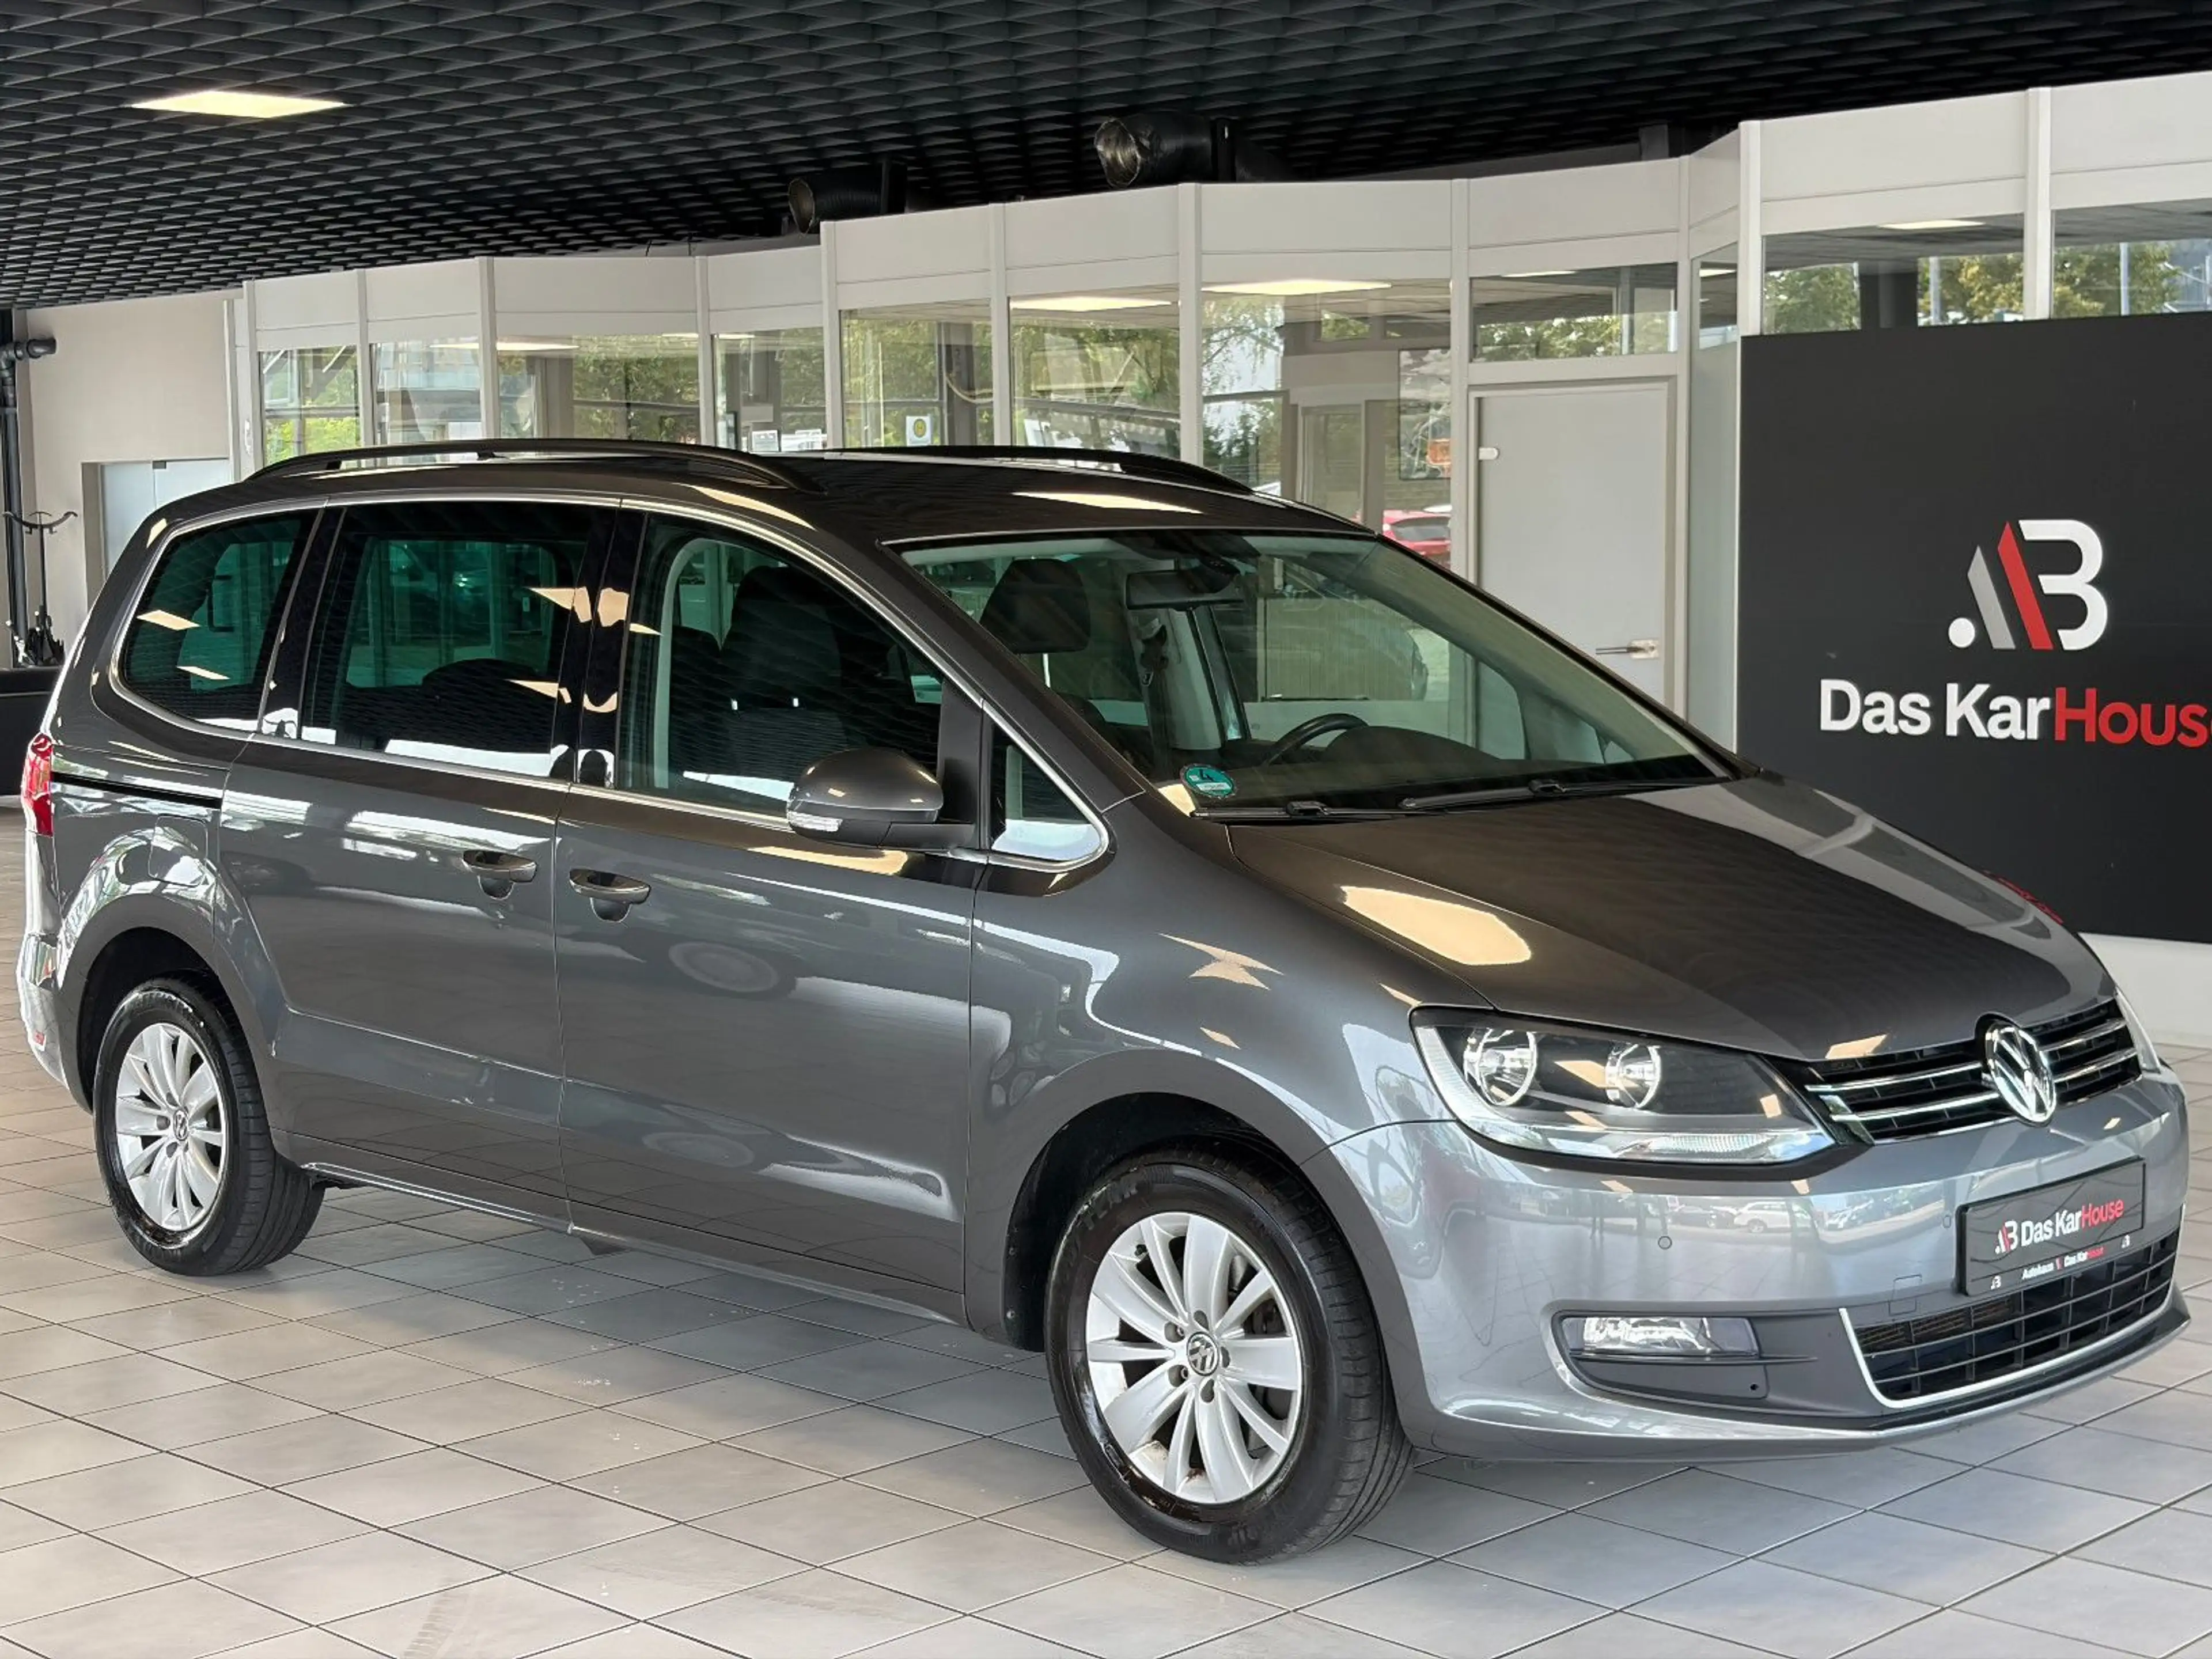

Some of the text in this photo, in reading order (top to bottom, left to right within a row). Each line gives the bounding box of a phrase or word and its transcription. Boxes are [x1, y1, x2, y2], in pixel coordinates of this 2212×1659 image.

[1820, 678, 2212, 749] Das KarHous
[2020, 1220, 2053, 1247] Das
[2055, 1198, 2124, 1237] KarHouse
